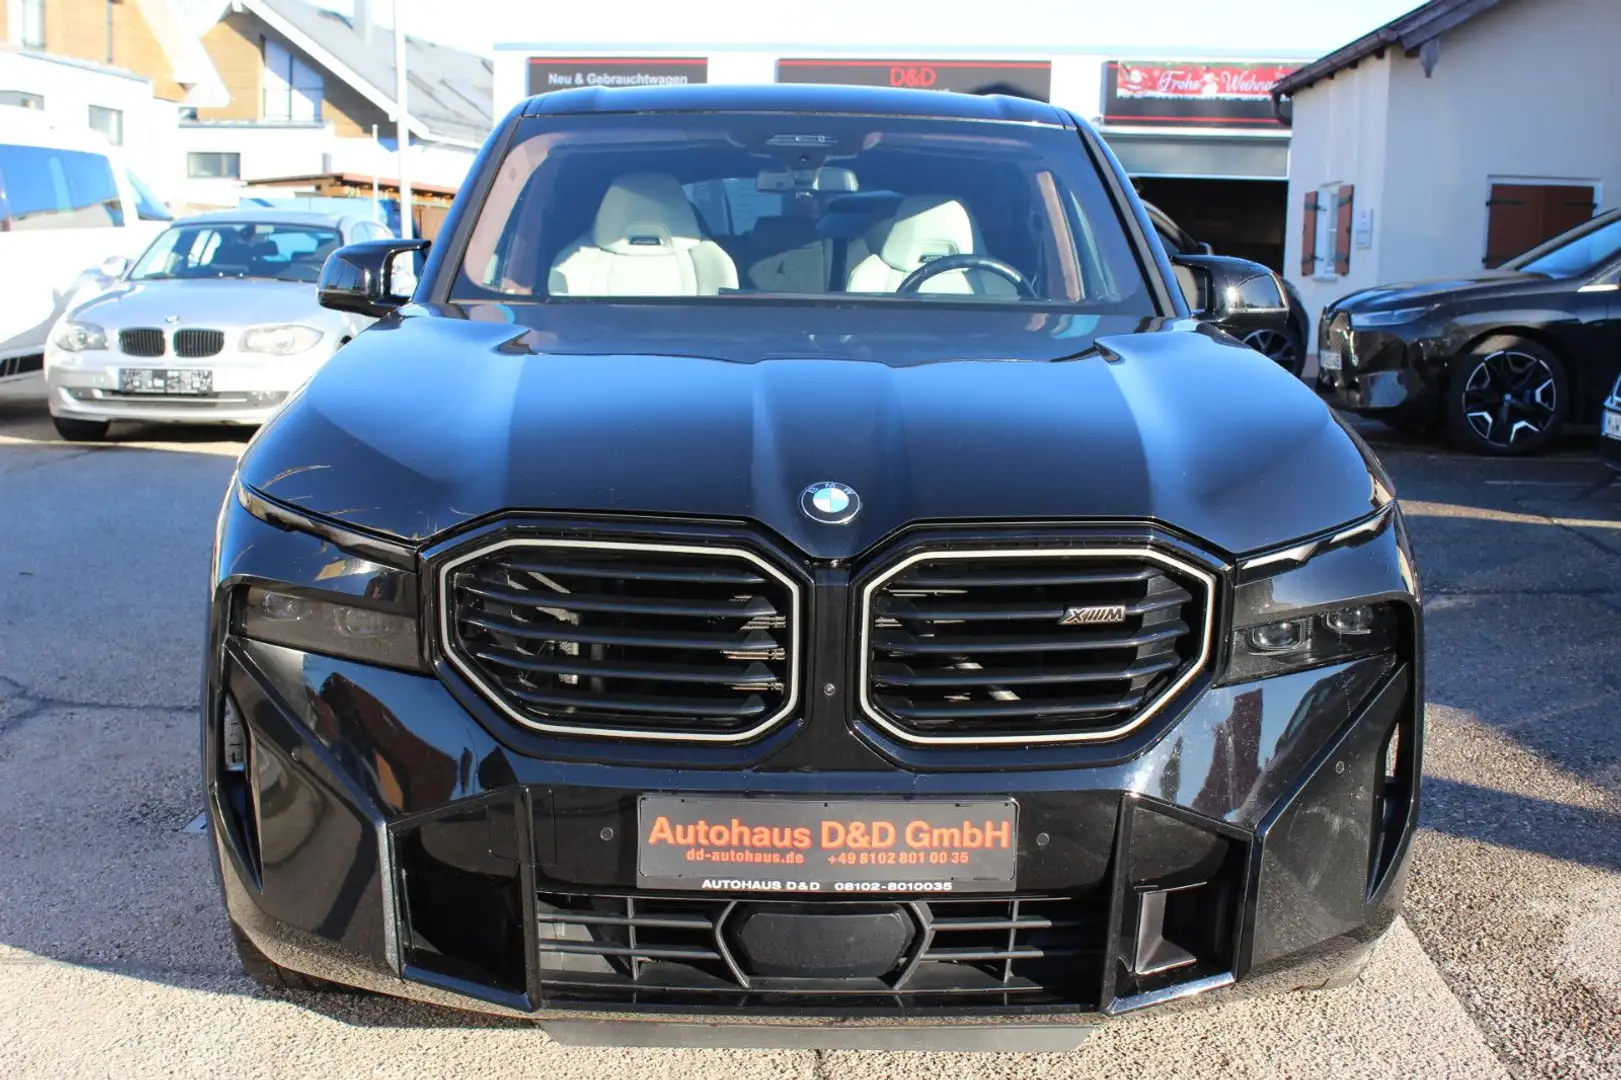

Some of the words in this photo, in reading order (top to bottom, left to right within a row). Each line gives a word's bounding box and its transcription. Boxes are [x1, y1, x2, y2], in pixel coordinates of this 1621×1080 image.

[548, 73, 572, 85] Neu
[574, 73, 584, 85] &
[586, 73, 689, 86] Gebrauchtwagen
[889, 66, 937, 88] D&D
[648, 816, 813, 848] Autohaus
[820, 820, 896, 848] D&D
[904, 820, 1010, 849] GmbH
[686, 849, 804, 864] dd-autohaus.de
[828, 852, 856, 865] +49
[859, 852, 896, 865] 8102
[899, 852, 925, 865] 801
[929, 852, 948, 865] 00
[951, 852, 969, 864] 35
[702, 879, 782, 890] AUTOHAUS
[786, 881, 821, 891] D&D
[834, 882, 953, 891] 08102-8010035
